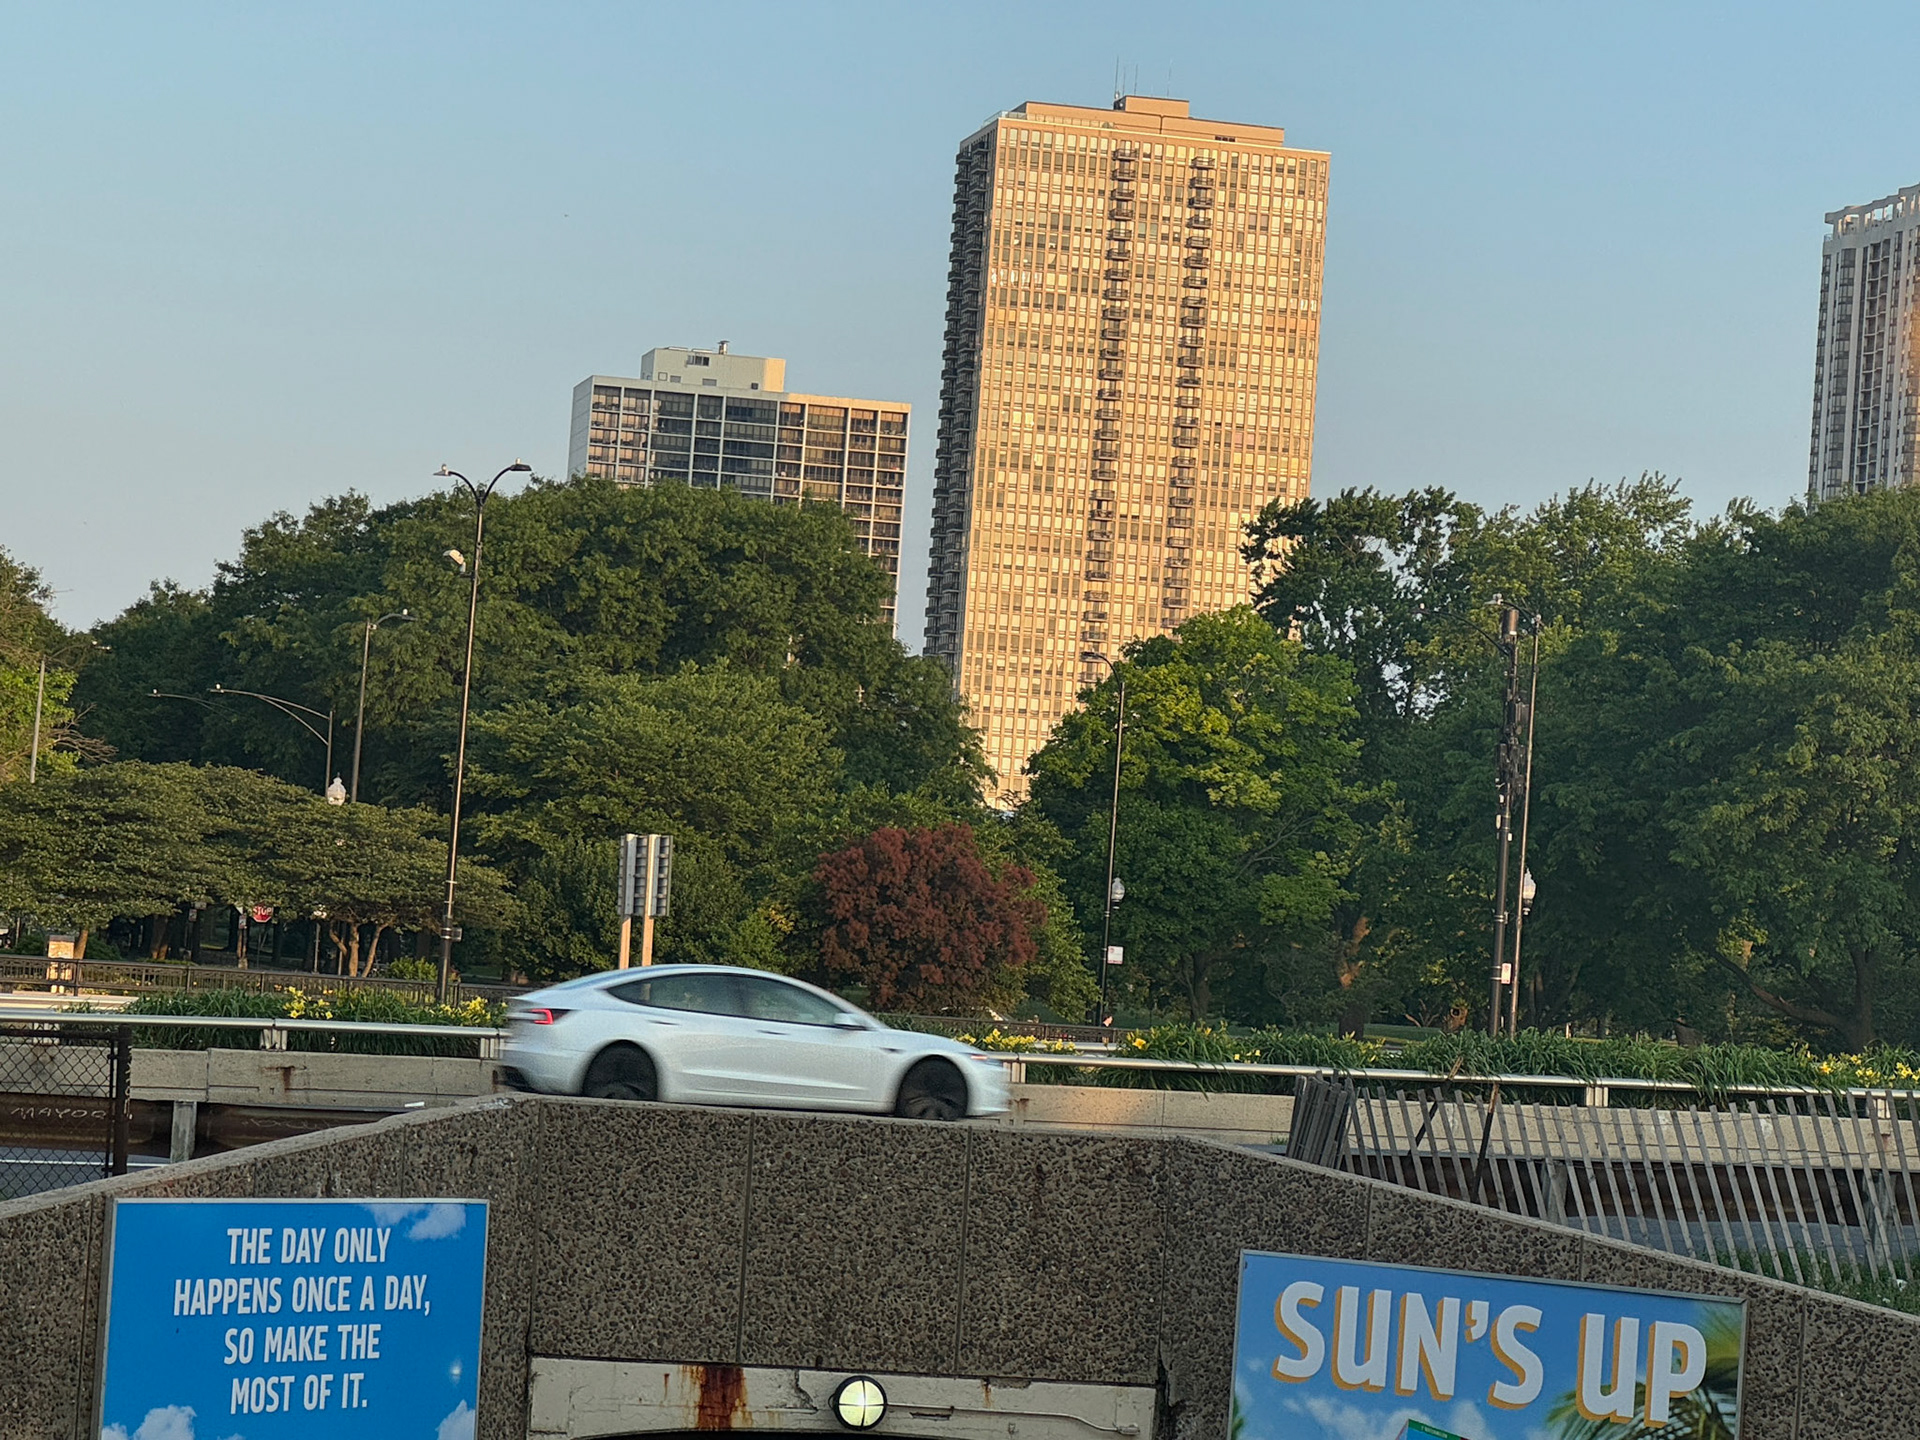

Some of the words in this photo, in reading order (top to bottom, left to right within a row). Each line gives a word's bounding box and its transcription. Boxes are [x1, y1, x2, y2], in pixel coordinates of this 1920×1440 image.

[227, 1228, 273, 1264] THE
[281, 1228, 326, 1264] DAY
[334, 1227, 391, 1263] ONLY
[173, 1277, 282, 1316] HAPPENS
[292, 1276, 352, 1313] ONCE
[360, 1276, 375, 1311] A
[384, 1274, 431, 1316] DAY,
[223, 1327, 255, 1365] SO
[264, 1325, 329, 1363] MAKE
[337, 1324, 381, 1360] THE
[1272, 1281, 1543, 1410] SUN'S
[1577, 1312, 1707, 1428] UP
[230, 1375, 295, 1415] MOST
[303, 1374, 334, 1411] OF
[341, 1373, 368, 1409] IT.
